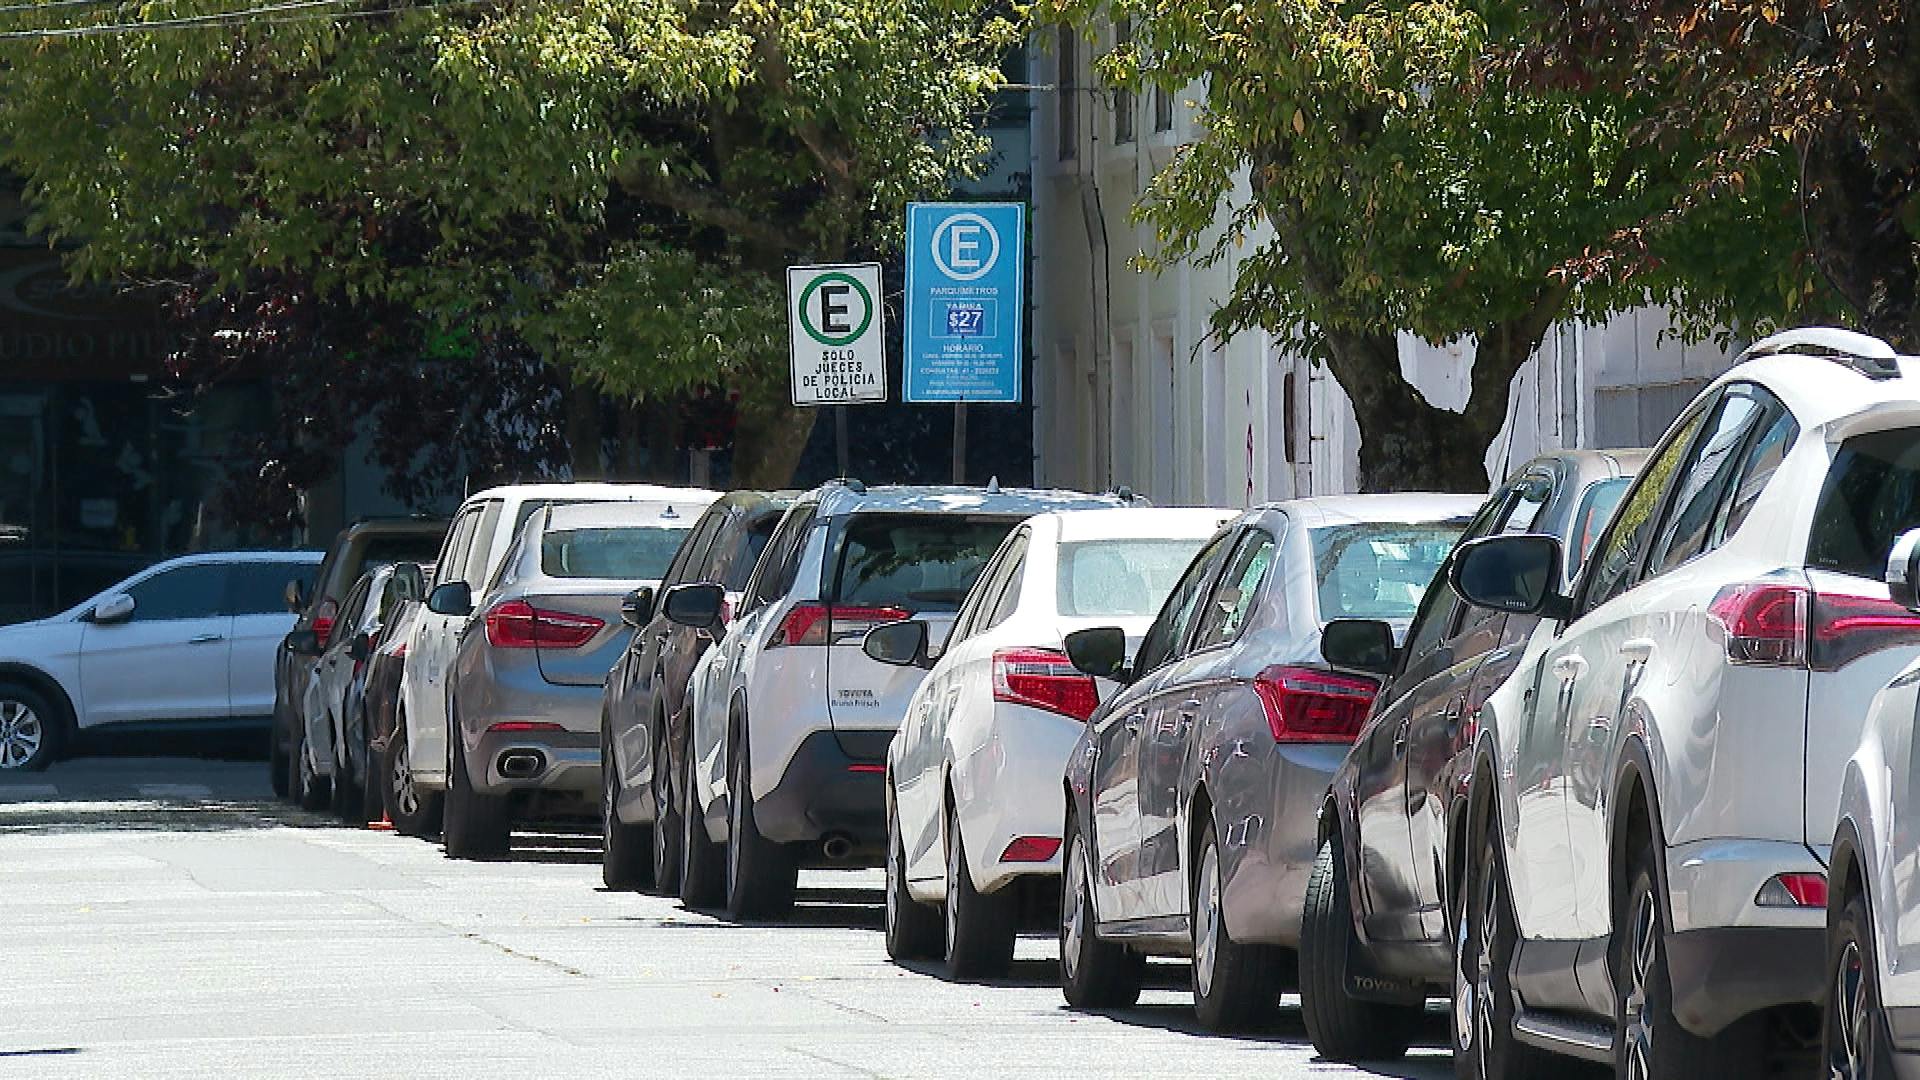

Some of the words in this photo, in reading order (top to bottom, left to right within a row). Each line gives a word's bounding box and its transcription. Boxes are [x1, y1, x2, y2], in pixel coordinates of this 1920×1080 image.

[951, 225, 980, 267] E
[821, 285, 851, 332] E
[949, 311, 982, 327] $27
[822, 349, 855, 361] SOLO
[943, 344, 983, 353] HORARIO
[815, 361, 863, 374] JUECES
[803, 376, 818, 387] DE
[824, 374, 875, 386] POLICIA
[816, 388, 857, 399] LOCAL
